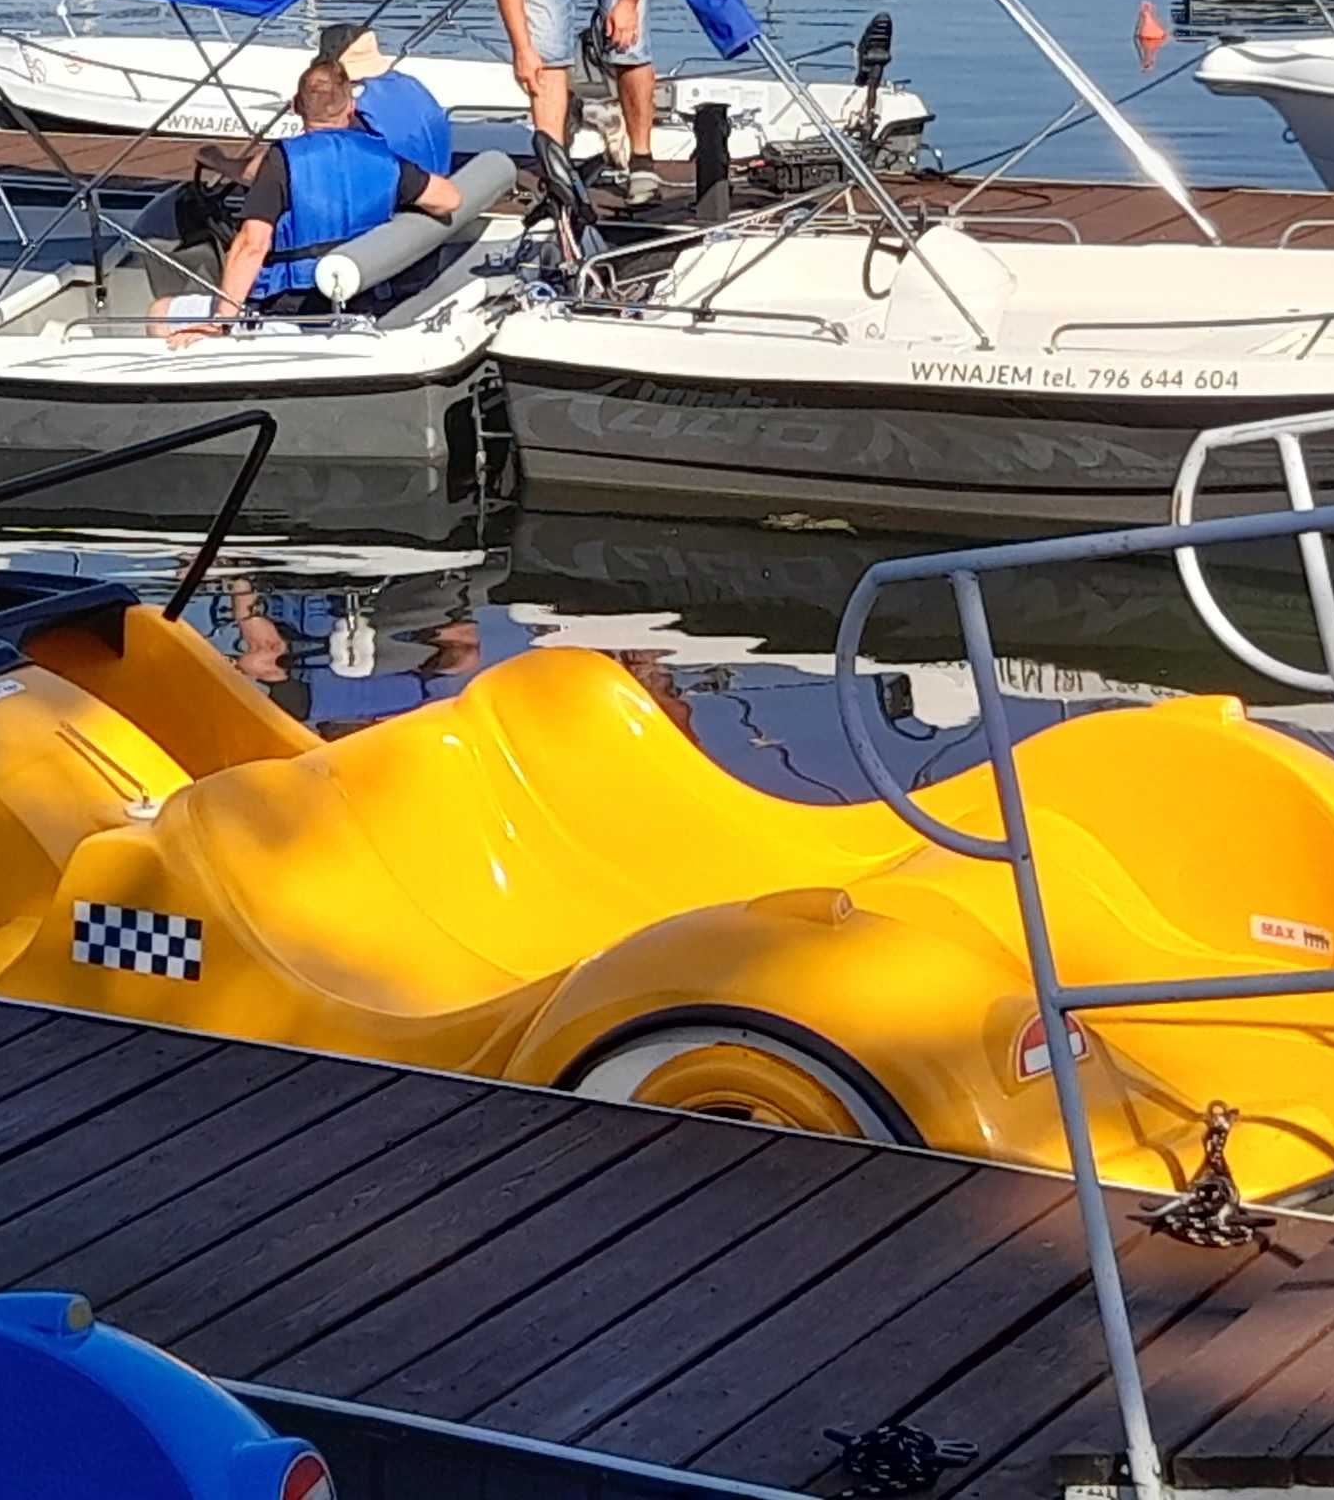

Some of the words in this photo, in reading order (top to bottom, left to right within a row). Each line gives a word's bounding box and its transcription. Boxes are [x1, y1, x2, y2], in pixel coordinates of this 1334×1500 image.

[910, 362, 1033, 386] WYNAJEM
[1042, 367, 1077, 388] tel.
[1087, 369, 1130, 389] 796
[1140, 369, 1183, 390] 644
[1194, 370, 1239, 390] 604
